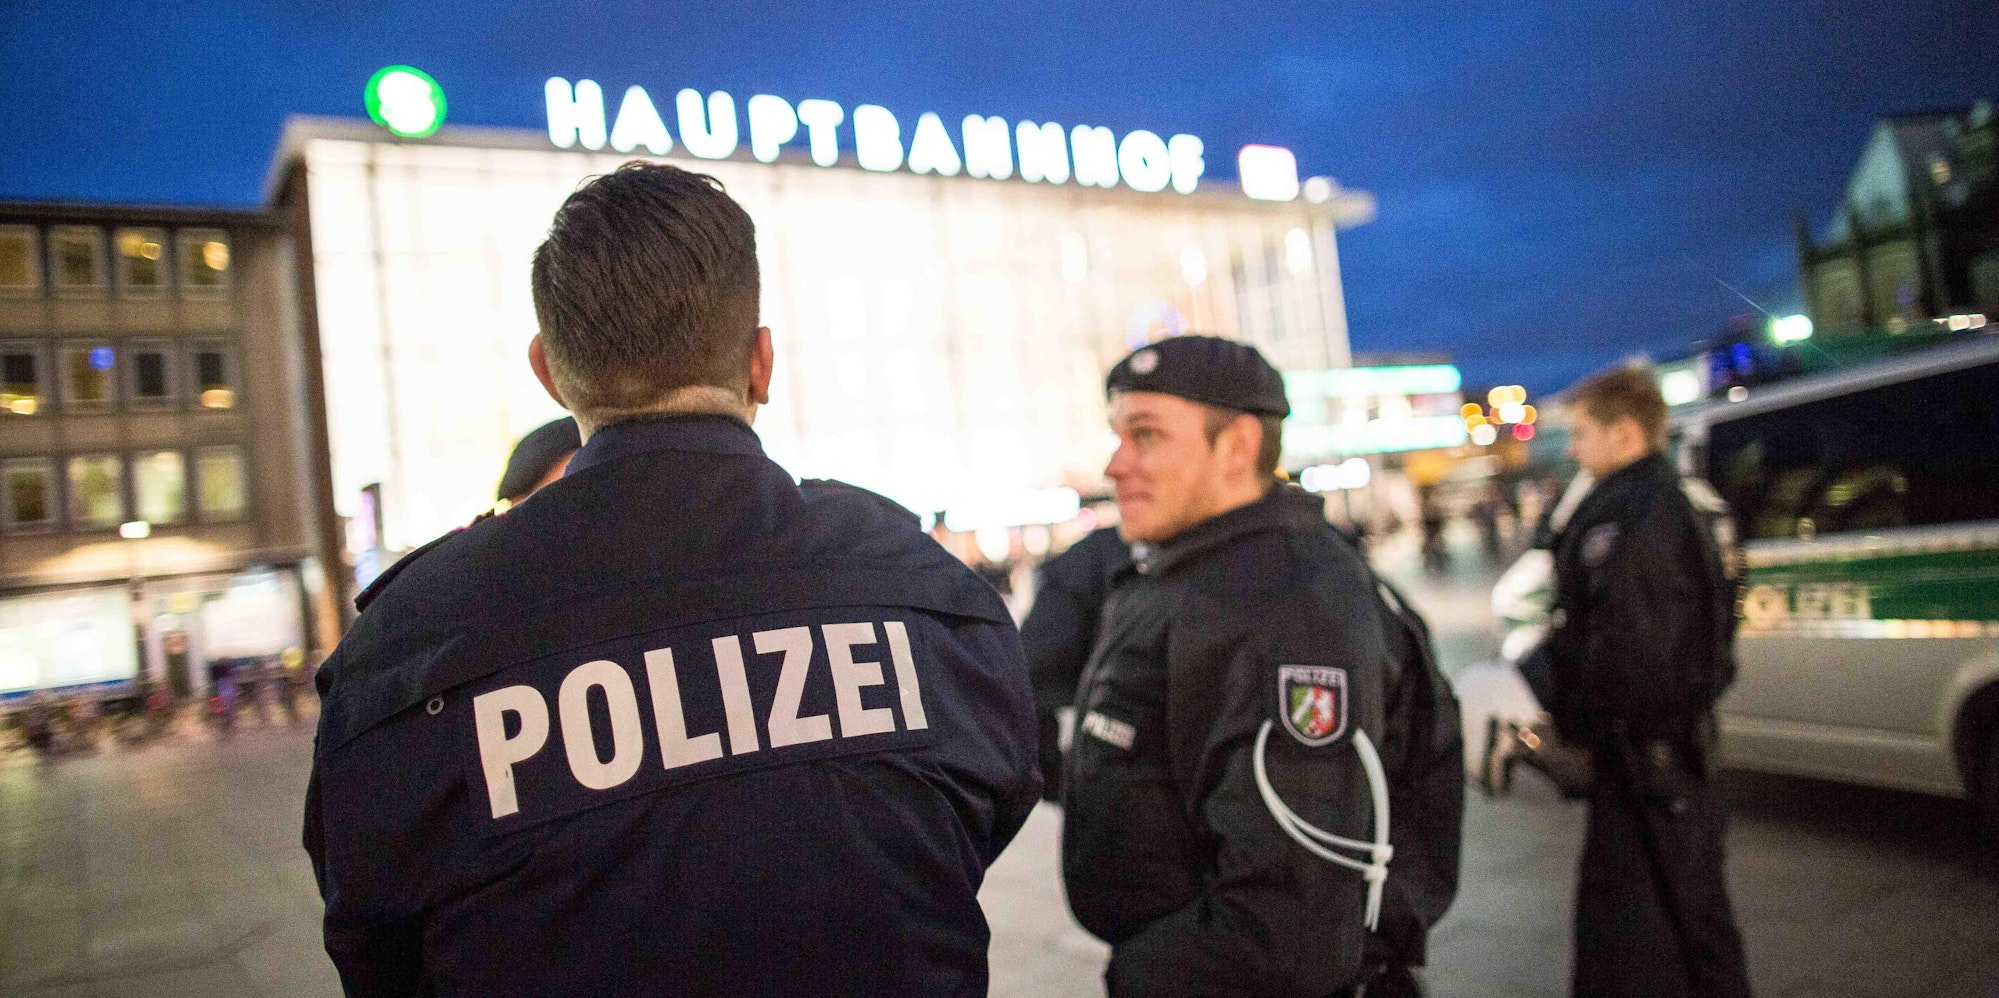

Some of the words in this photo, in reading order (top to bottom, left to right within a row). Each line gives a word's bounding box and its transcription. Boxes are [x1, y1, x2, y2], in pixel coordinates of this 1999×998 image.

[545, 76, 1205, 194] HAUPTBAHNHOF
[1734, 580, 1872, 624] OLIZEI
[473, 621, 928, 818] POLIZEI
